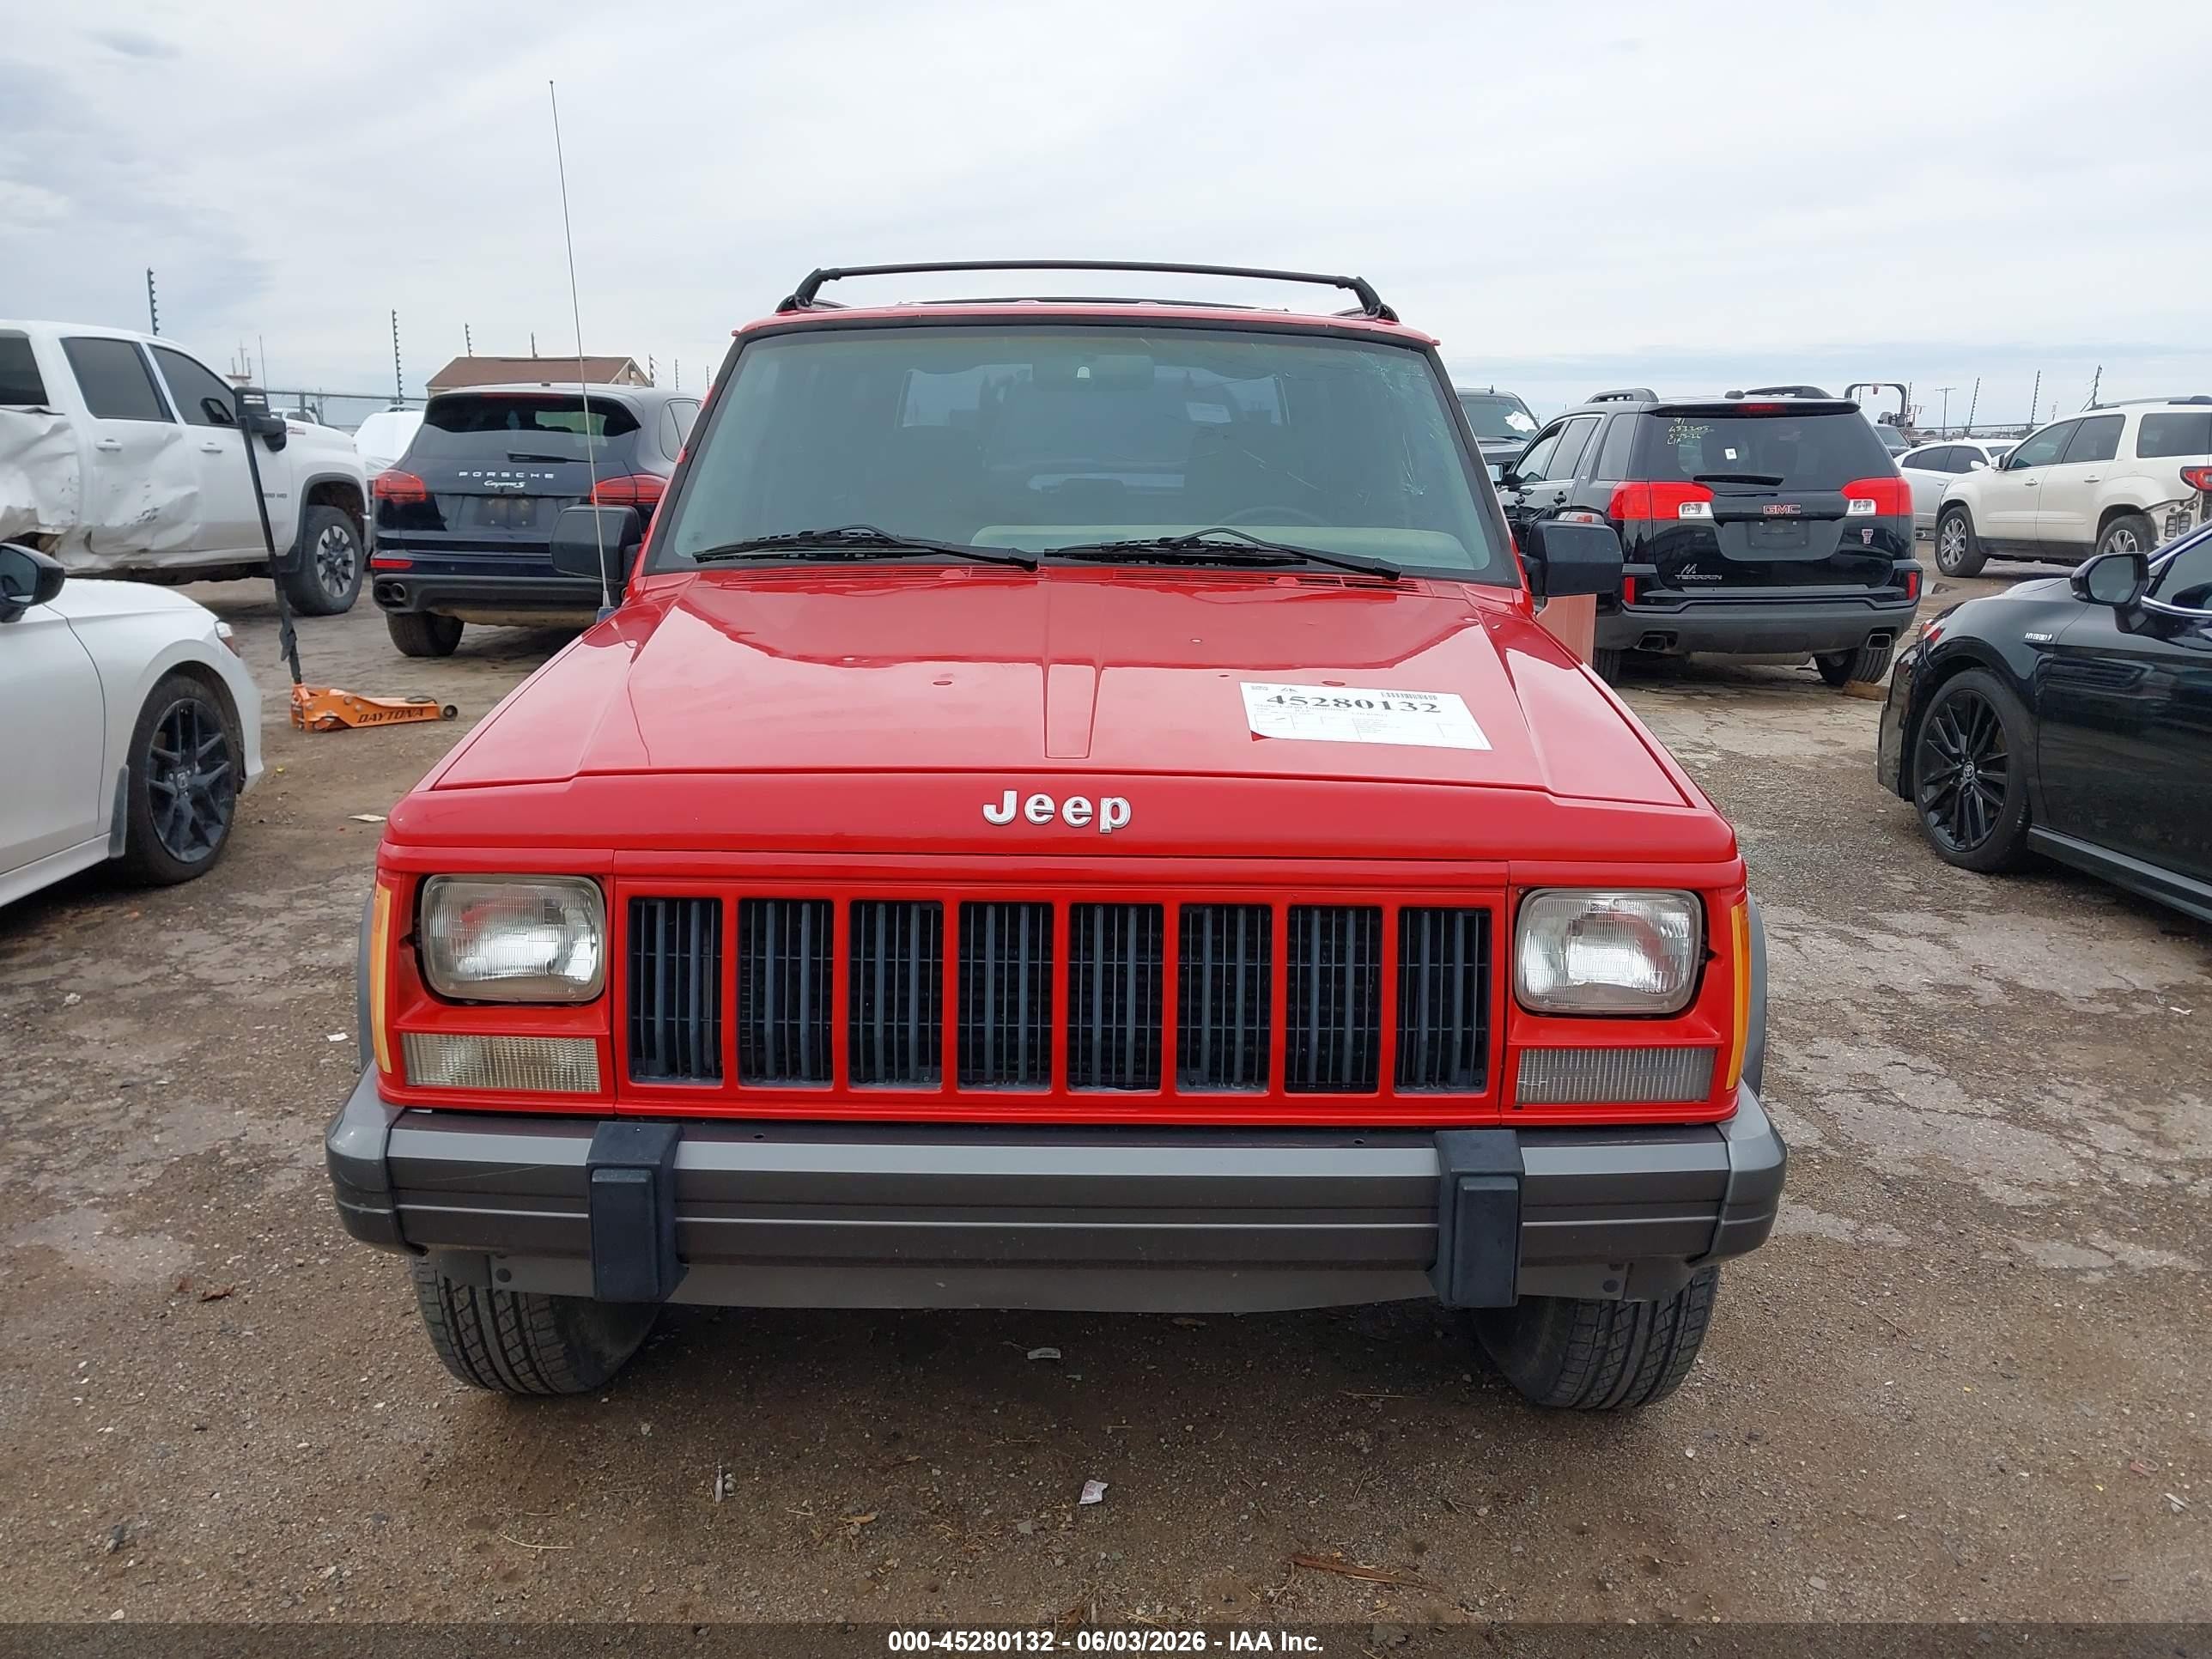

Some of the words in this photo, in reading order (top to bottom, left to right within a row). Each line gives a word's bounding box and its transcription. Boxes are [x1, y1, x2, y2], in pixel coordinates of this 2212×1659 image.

[459, 471, 555, 479] PORSCHE
[1763, 504, 1802, 514] GMC
[2024, 632, 2048, 641] HYBRID
[1267, 695, 1442, 714] 45280132
[357, 708, 424, 723] DAYTONA
[982, 790, 1132, 834] Jeep
